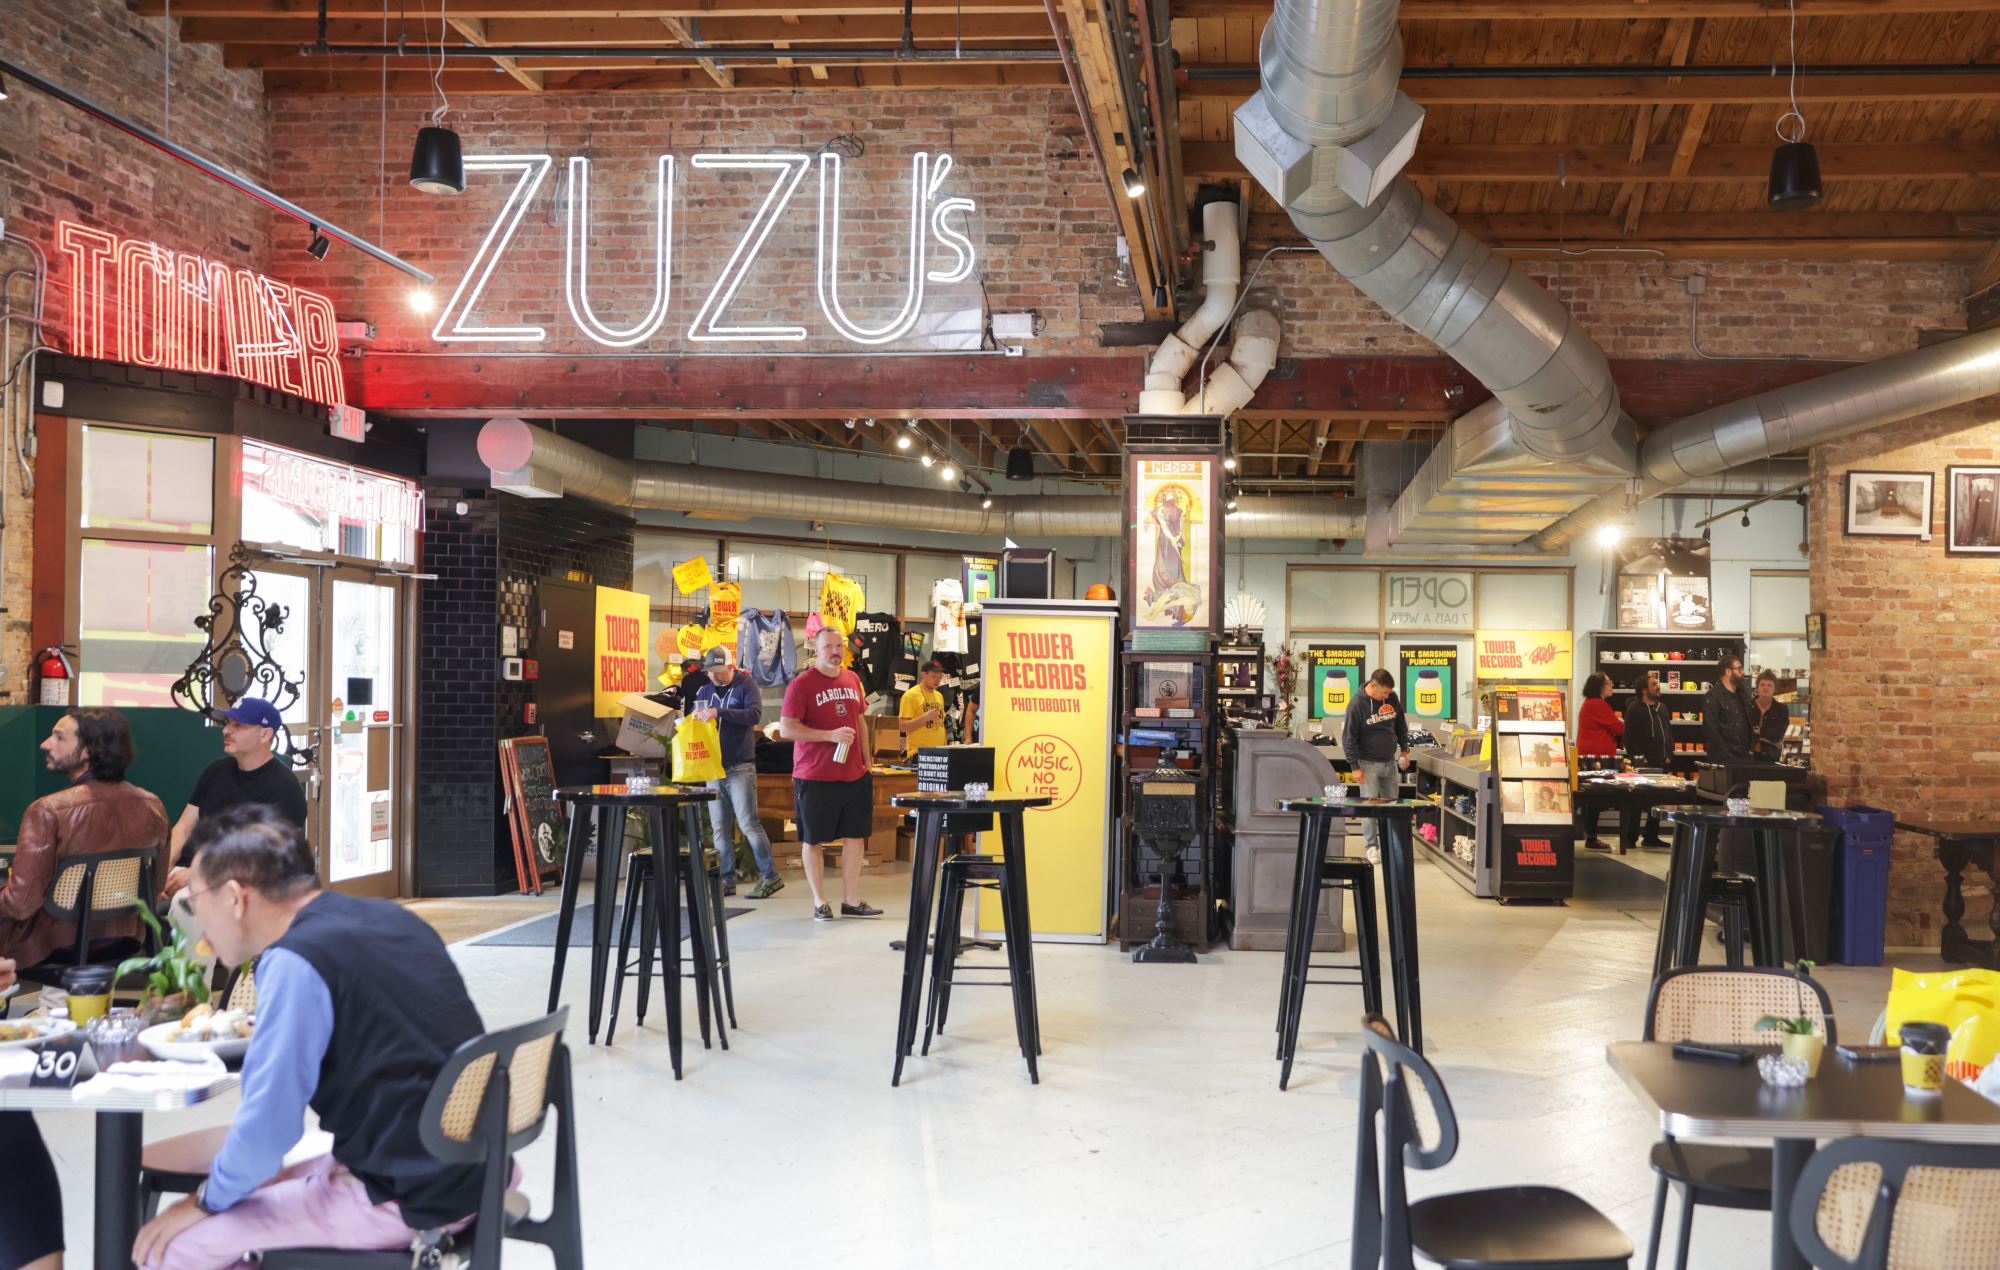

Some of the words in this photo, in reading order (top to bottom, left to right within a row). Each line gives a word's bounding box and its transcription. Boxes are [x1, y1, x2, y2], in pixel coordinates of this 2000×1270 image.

[59, 220, 345, 406] TOWER
[341, 406, 364, 437] EXIT
[605, 614, 640, 654] TOWER
[1007, 632, 1074, 660] TOWER
[1483, 640, 1516, 653] TOWER
[1310, 650, 1324, 658] THE
[1326, 650, 1365, 658] SMASHING
[1400, 650, 1416, 658] THE
[1417, 650, 1457, 658] SMASHING
[1317, 657, 1357, 665] PUMPKINS
[1409, 658, 1449, 666] PUMPKINS
[1479, 655, 1523, 668] RECORDS
[600, 655, 647, 692] RECORDS
[999, 662, 1087, 691] RECORDS
[815, 687, 860, 707] CAROLINA
[1011, 697, 1081, 713] PHOTOBOOTH
[688, 741, 705, 751] TOWER
[1034, 742, 1056, 755] NO
[918, 763, 948, 771] PHOTOGRAPHY
[1017, 755, 1074, 772] MUSIC,
[1032, 772, 1056, 785] NO
[918, 782, 947, 792] ORIGINAL
[1520, 839, 1551, 852] TOWER
[1517, 852, 1556, 866] RECORDS
[36, 1050, 77, 1079] 30
